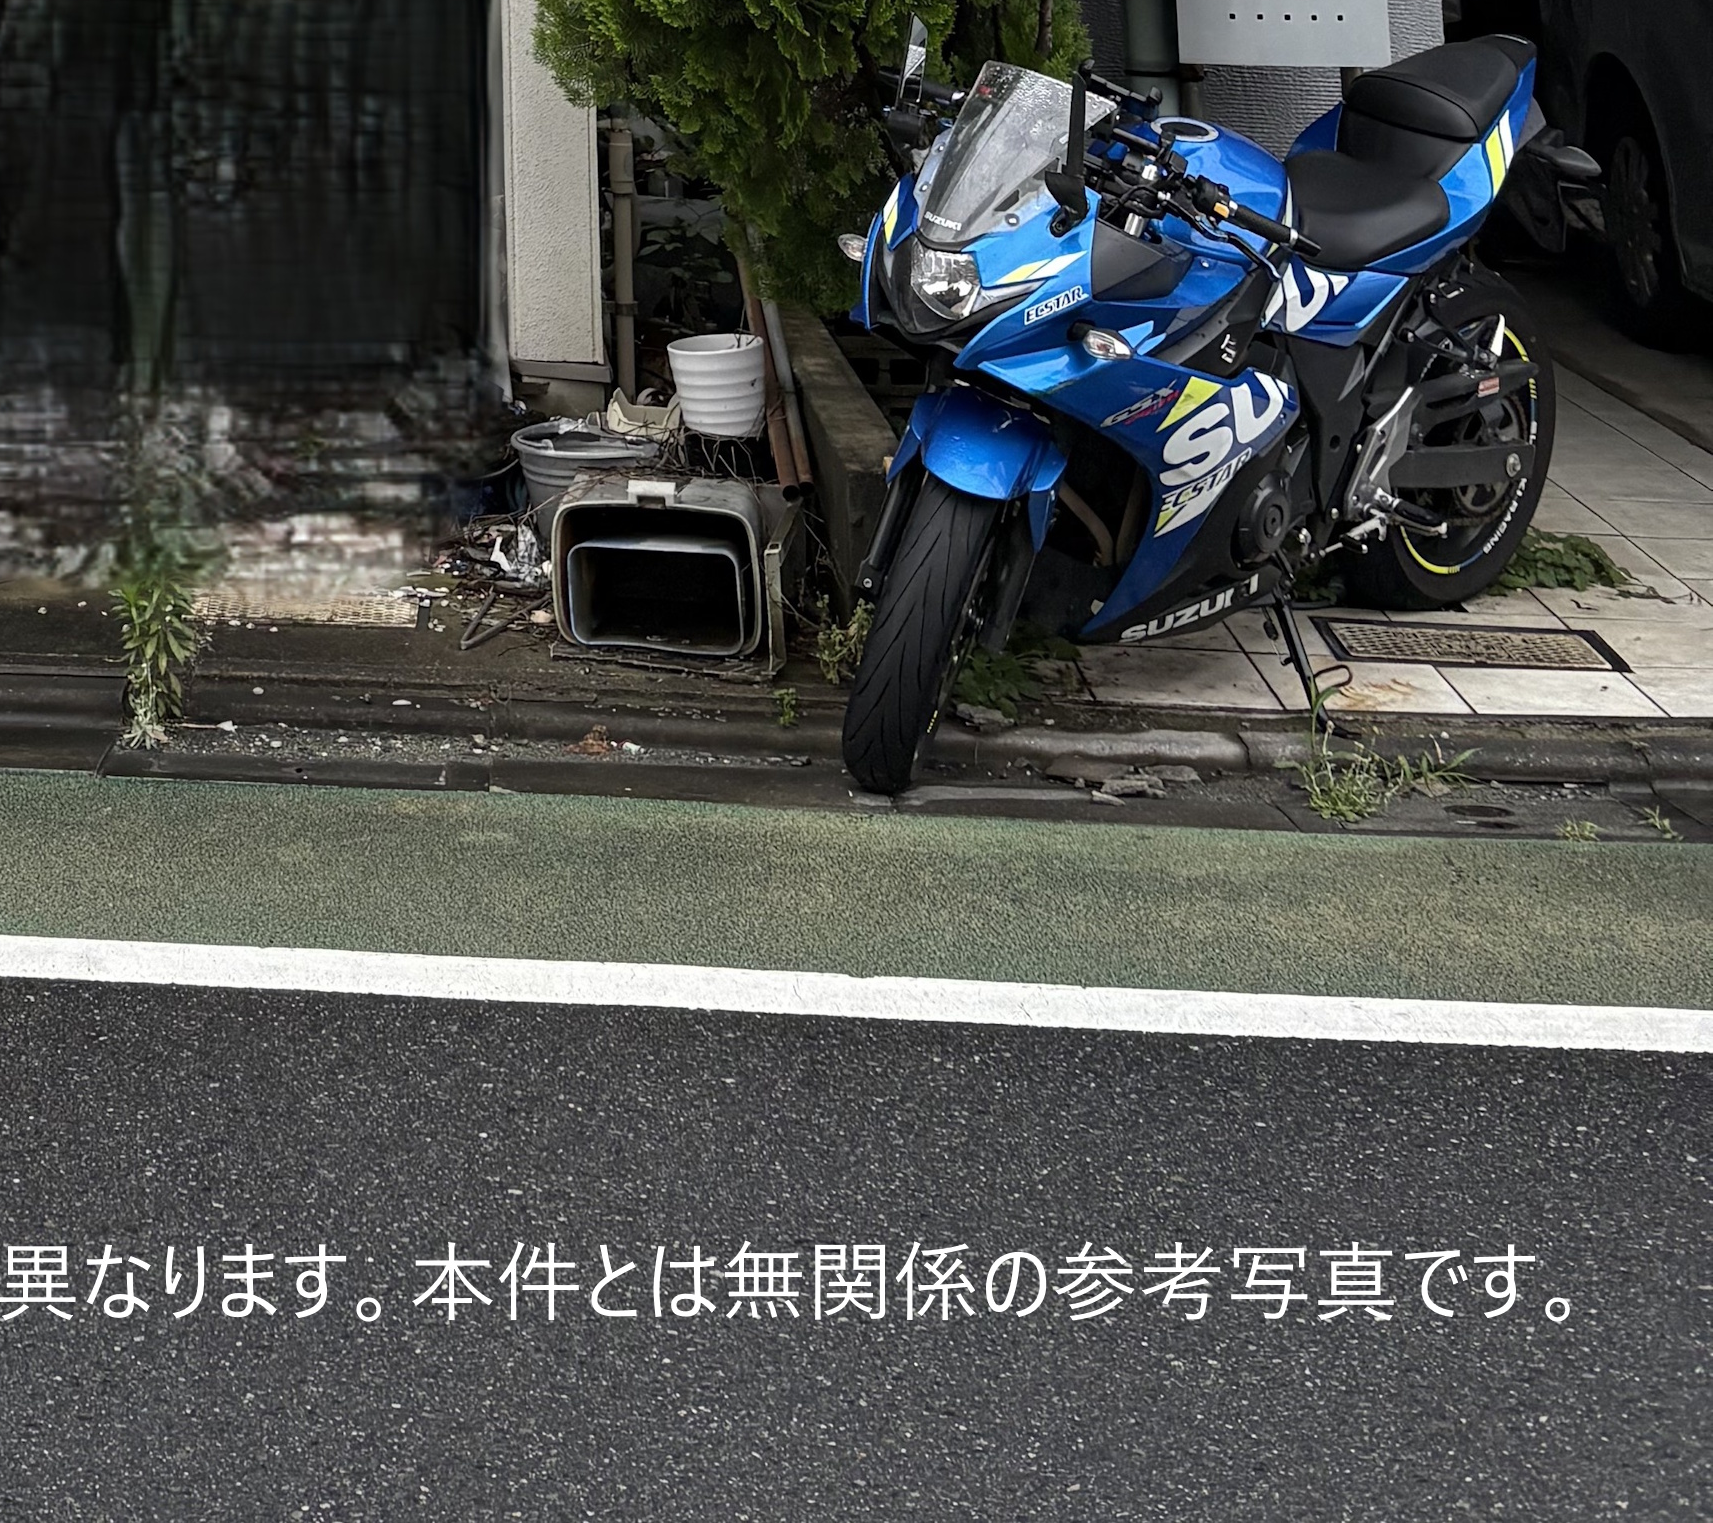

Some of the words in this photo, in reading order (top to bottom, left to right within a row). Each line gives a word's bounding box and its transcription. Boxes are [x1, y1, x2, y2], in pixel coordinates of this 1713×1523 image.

[924, 211, 962, 231] SUZUKI
[1025, 285, 1089, 326] ECSTAR
[1159, 371, 1289, 487] SU
